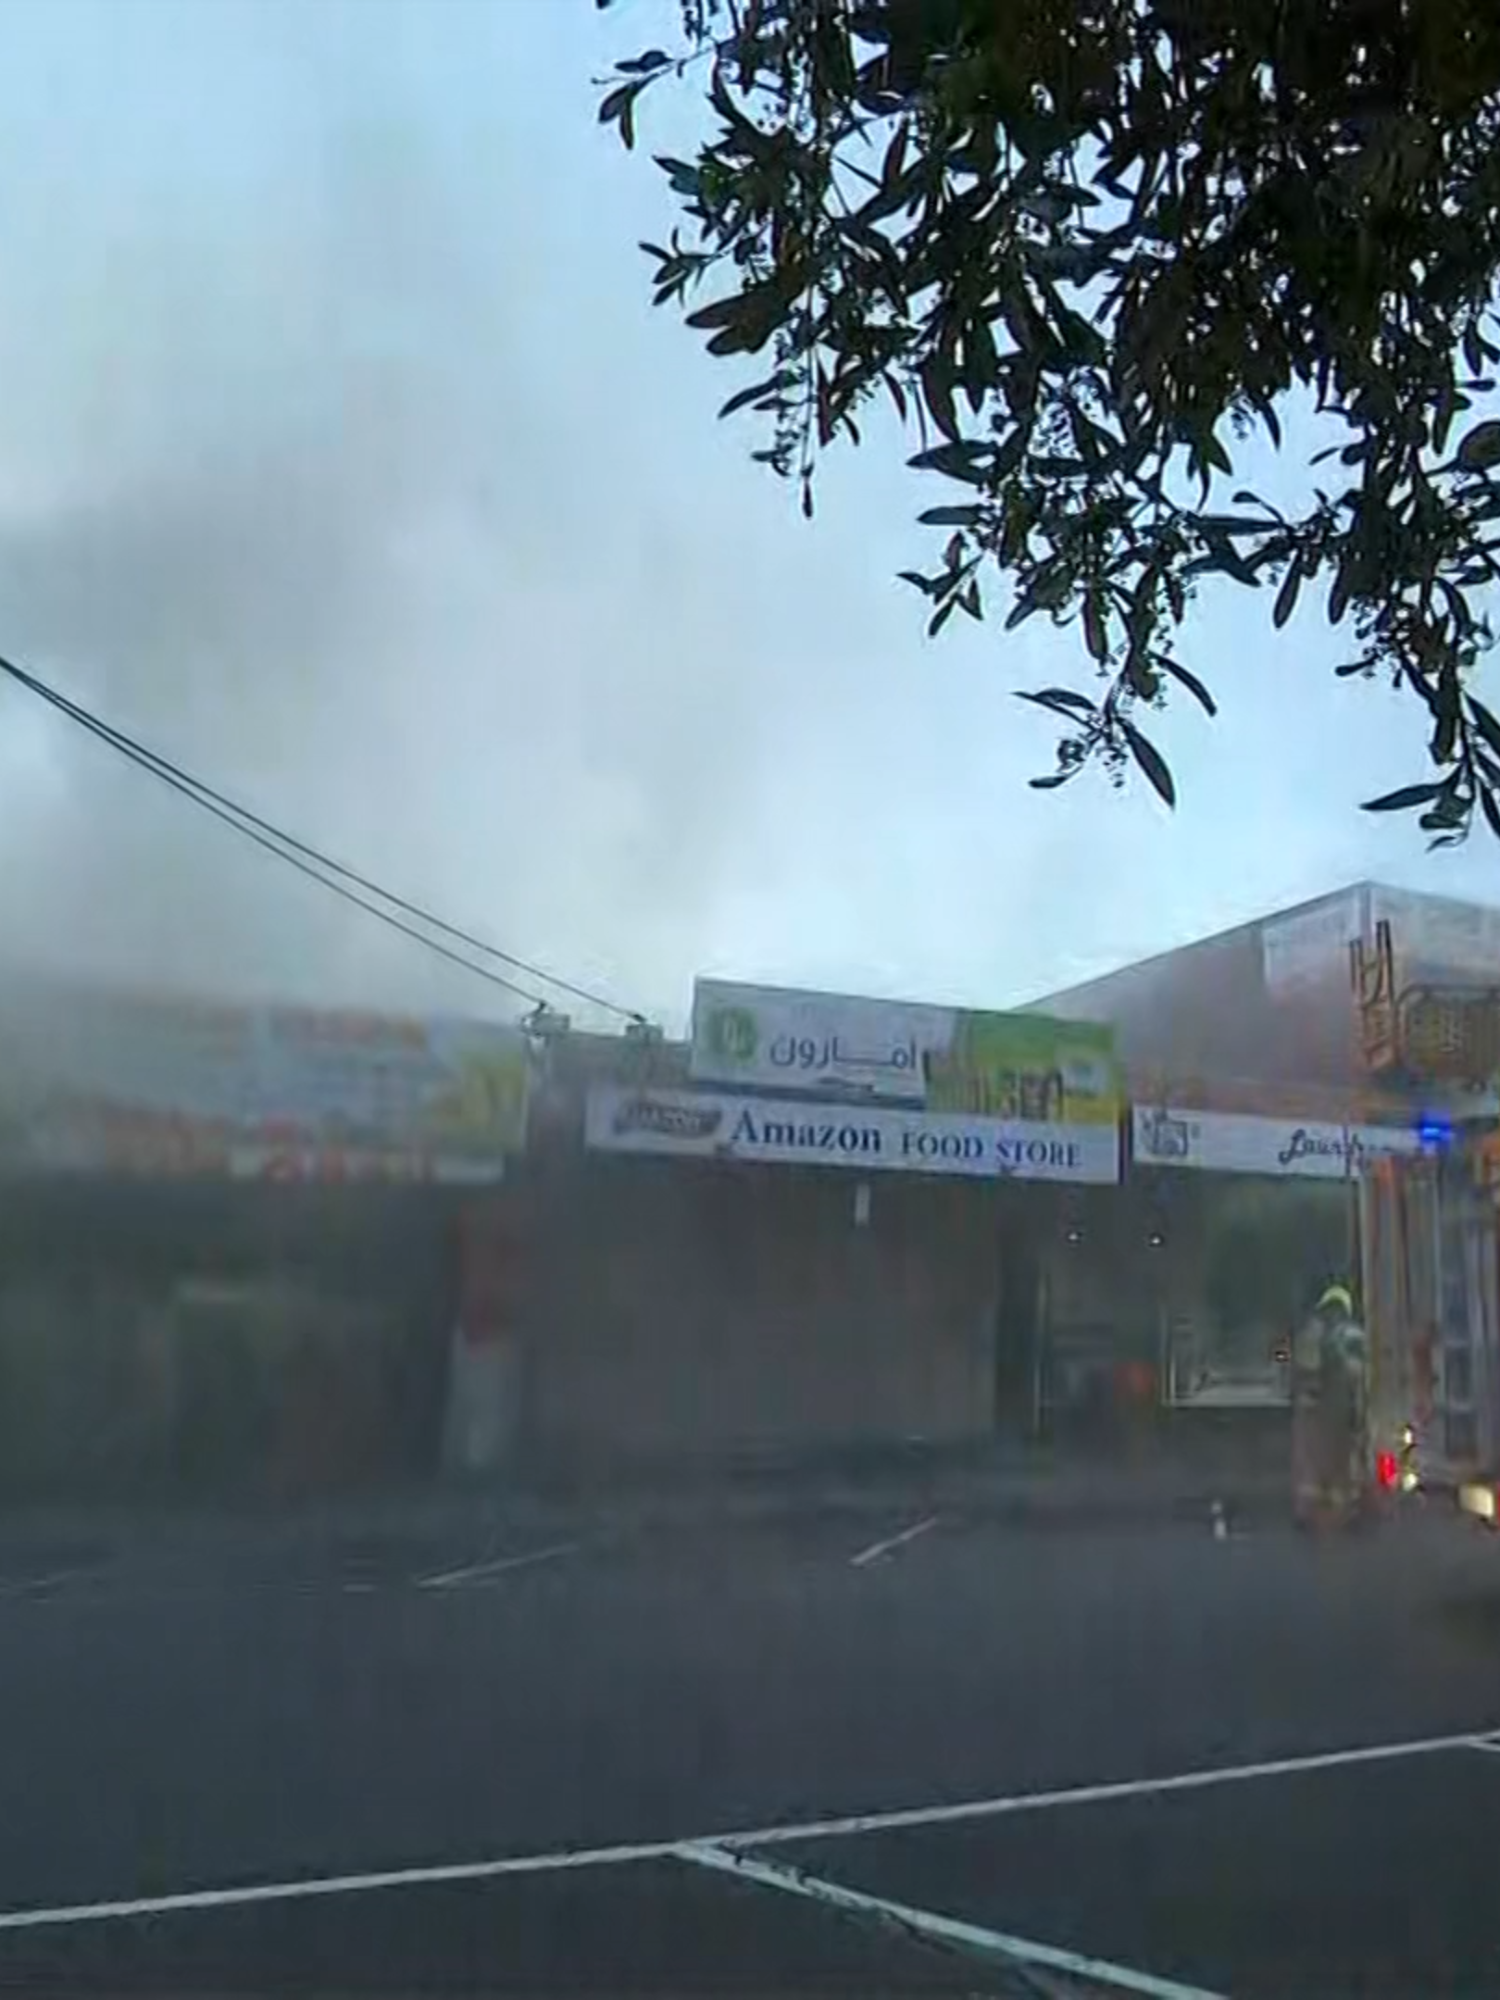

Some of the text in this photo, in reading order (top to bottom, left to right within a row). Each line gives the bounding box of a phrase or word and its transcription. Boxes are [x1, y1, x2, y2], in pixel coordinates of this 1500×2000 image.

[731, 1108, 882, 1152] Amazon
[902, 1131, 983, 1158] FOOD
[995, 1138, 1082, 1168] STORE
